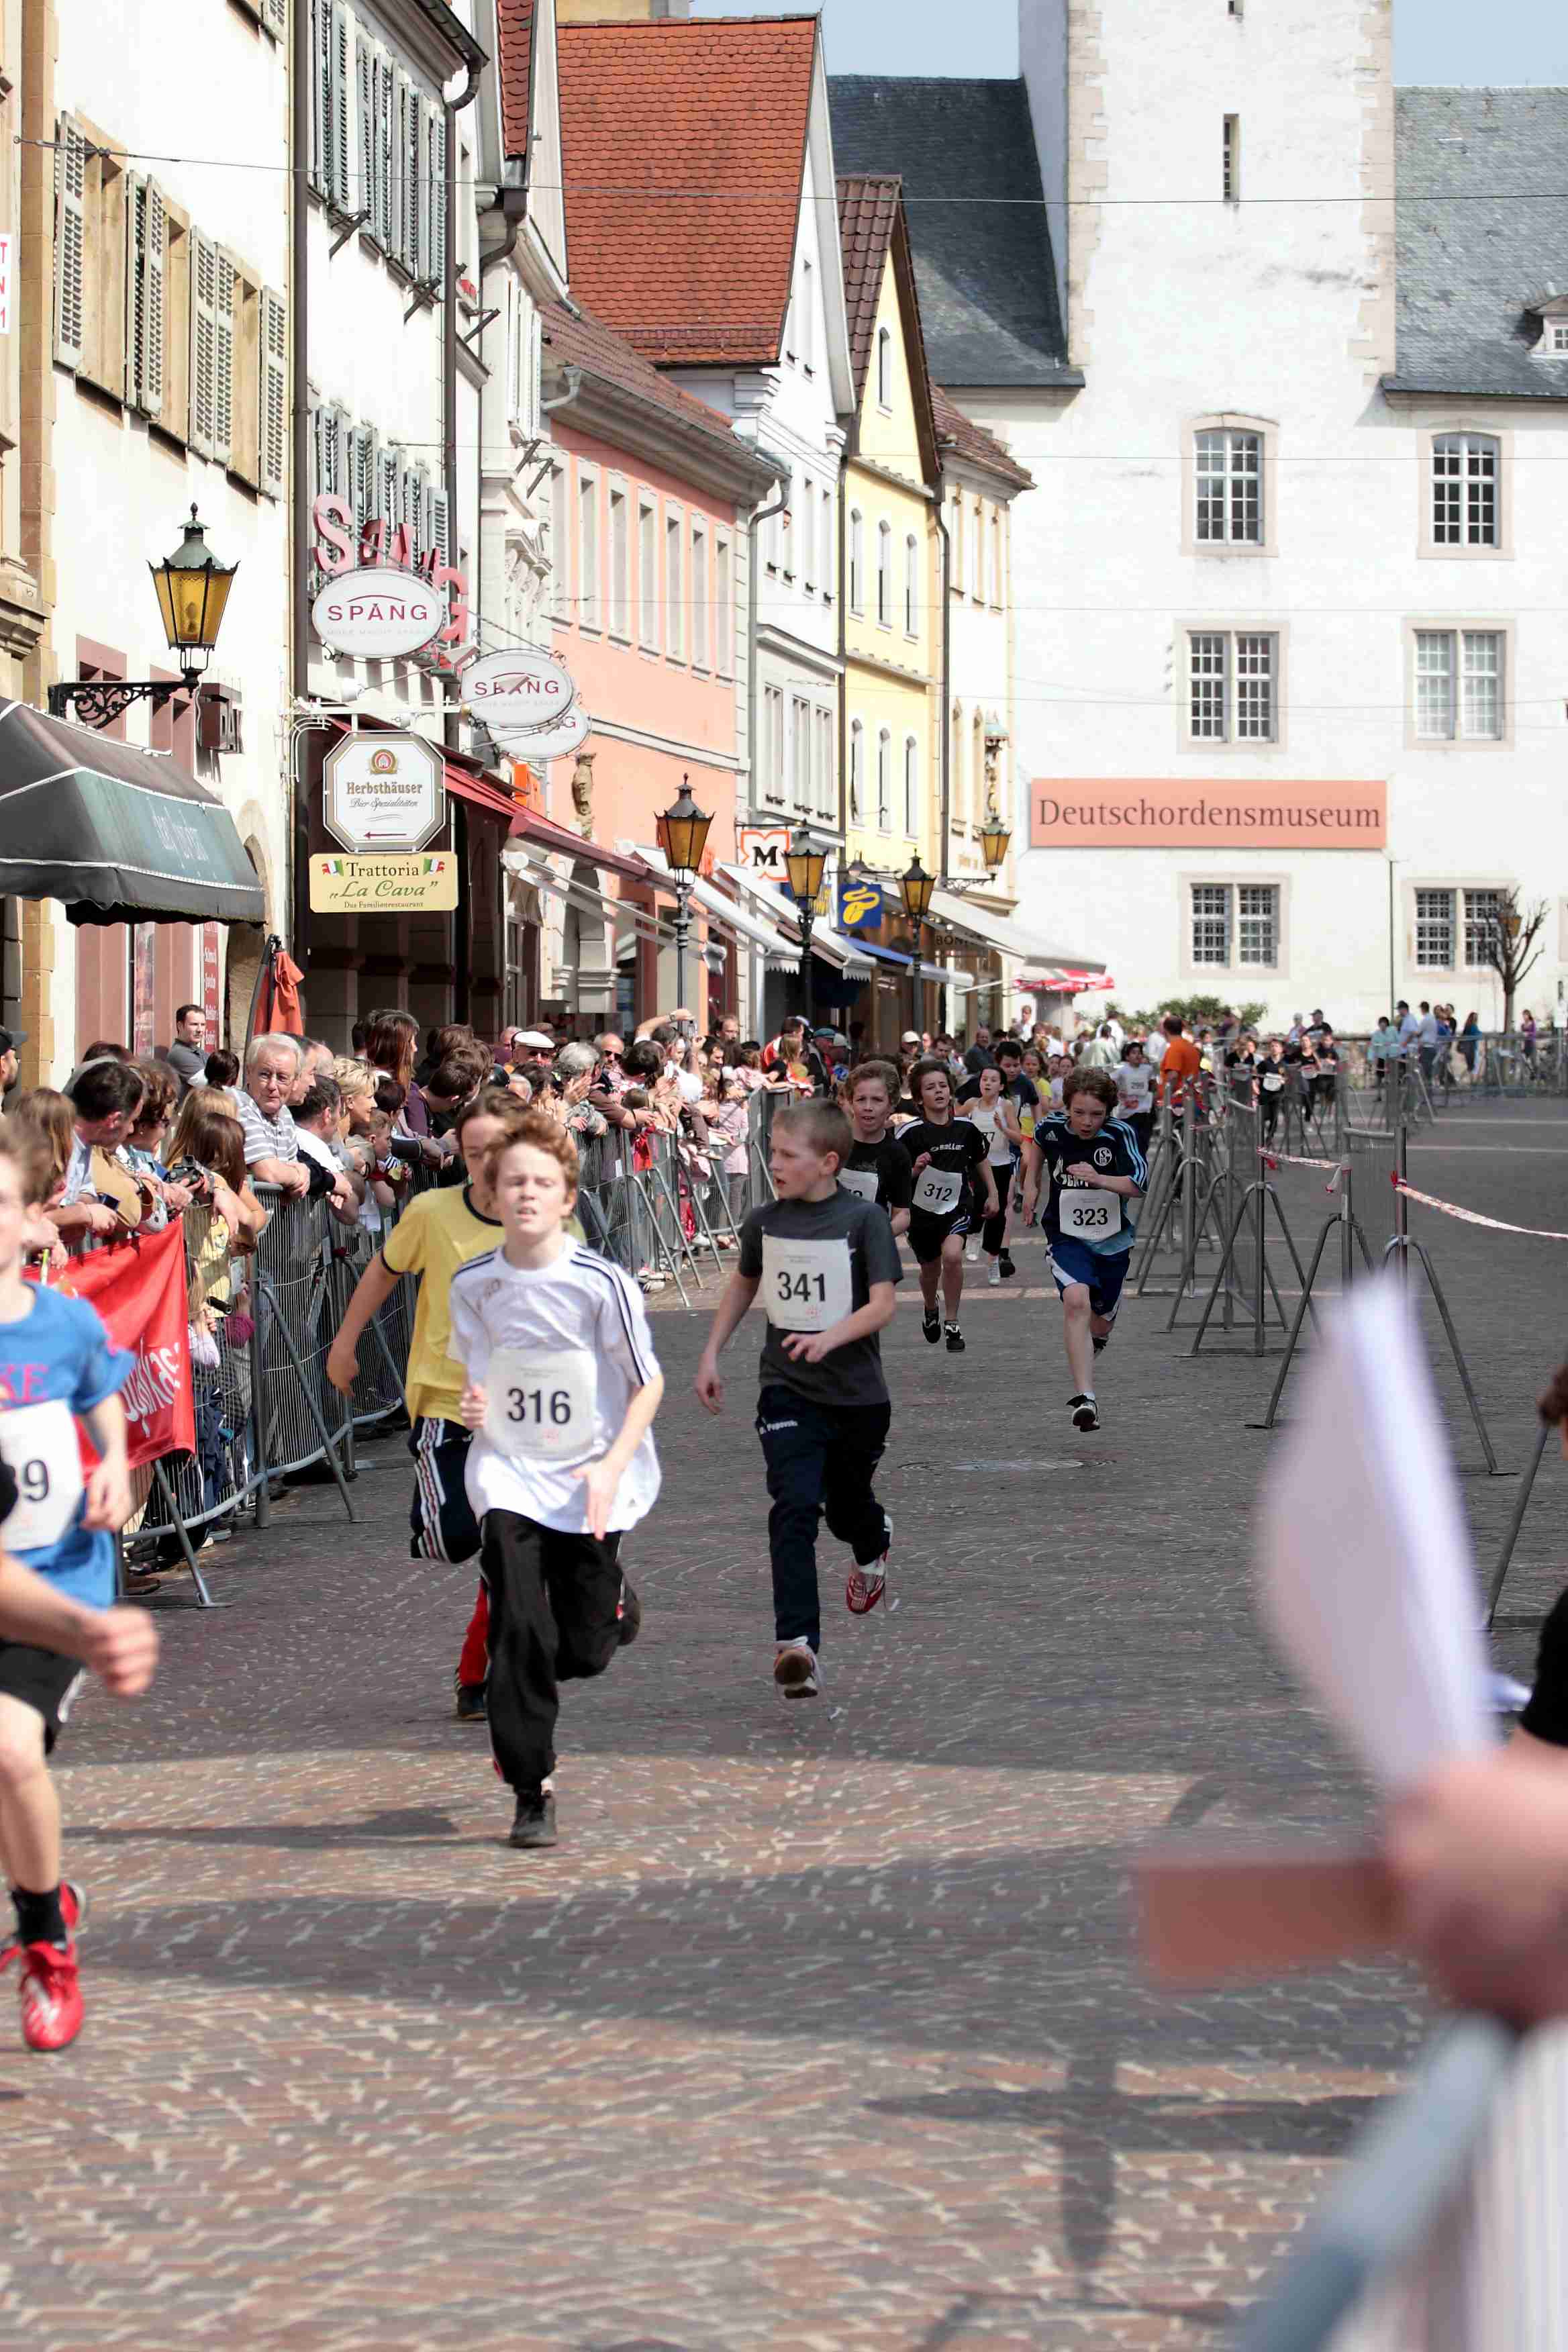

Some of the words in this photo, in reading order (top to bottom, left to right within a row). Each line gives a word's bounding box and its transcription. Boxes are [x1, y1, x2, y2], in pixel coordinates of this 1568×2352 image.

[346, 781, 423, 795] Herbsthäuser
[1038, 798, 1381, 828] Deutschordensmuseum
[346, 862, 419, 877] Trattoria
[924, 1183, 952, 1202] 312
[1073, 1208, 1108, 1226] 323
[777, 1271, 826, 1302] 341
[507, 1387, 571, 1424] 316
